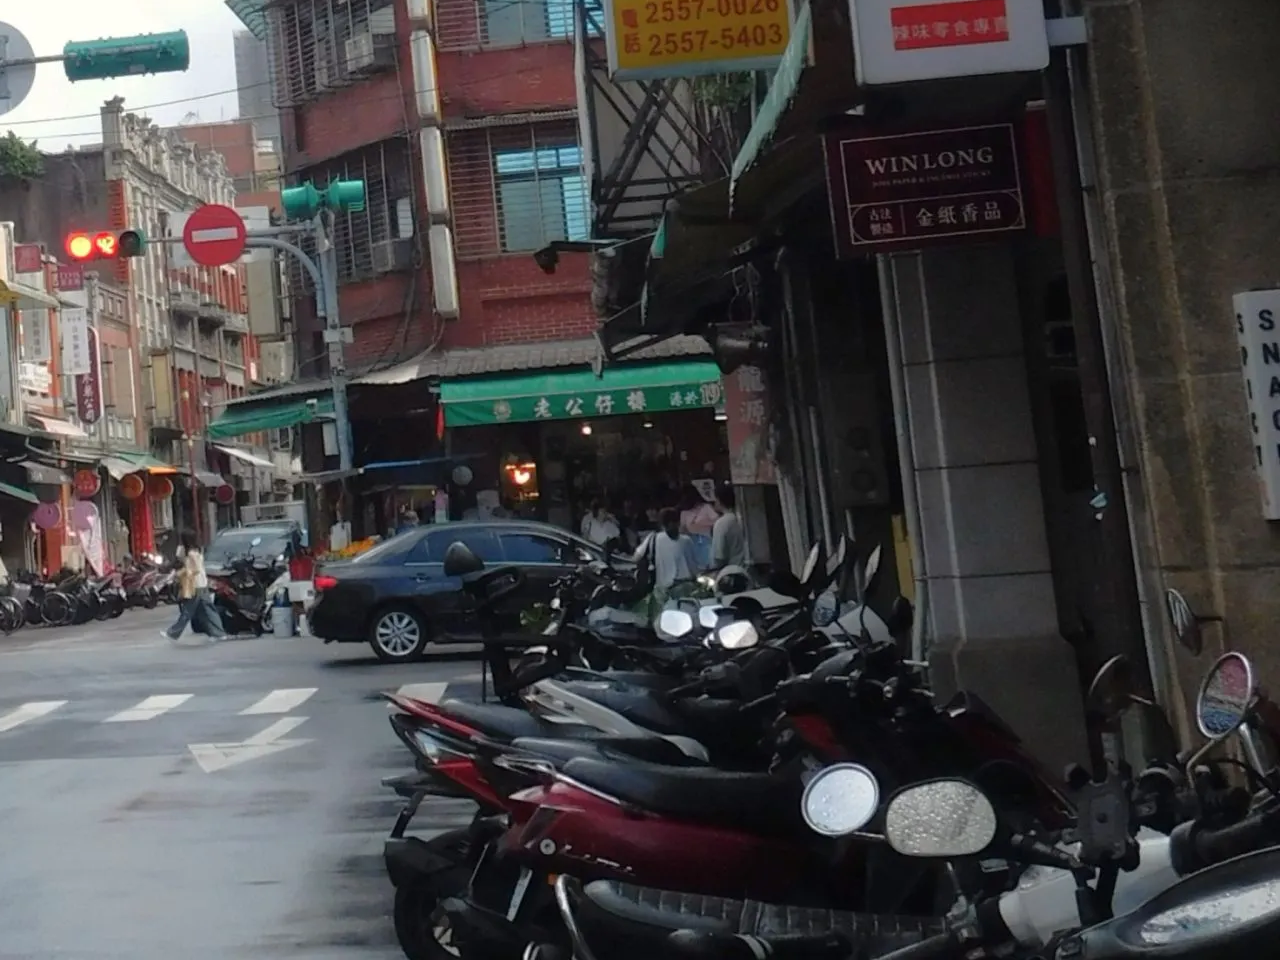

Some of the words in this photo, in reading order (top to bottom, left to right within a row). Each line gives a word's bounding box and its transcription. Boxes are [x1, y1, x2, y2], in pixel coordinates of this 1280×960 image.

[649, 23, 783, 57] 2557-5403
[865, 146, 994, 176] WINLONG
[916, 201, 1001, 227] 金紙香品
